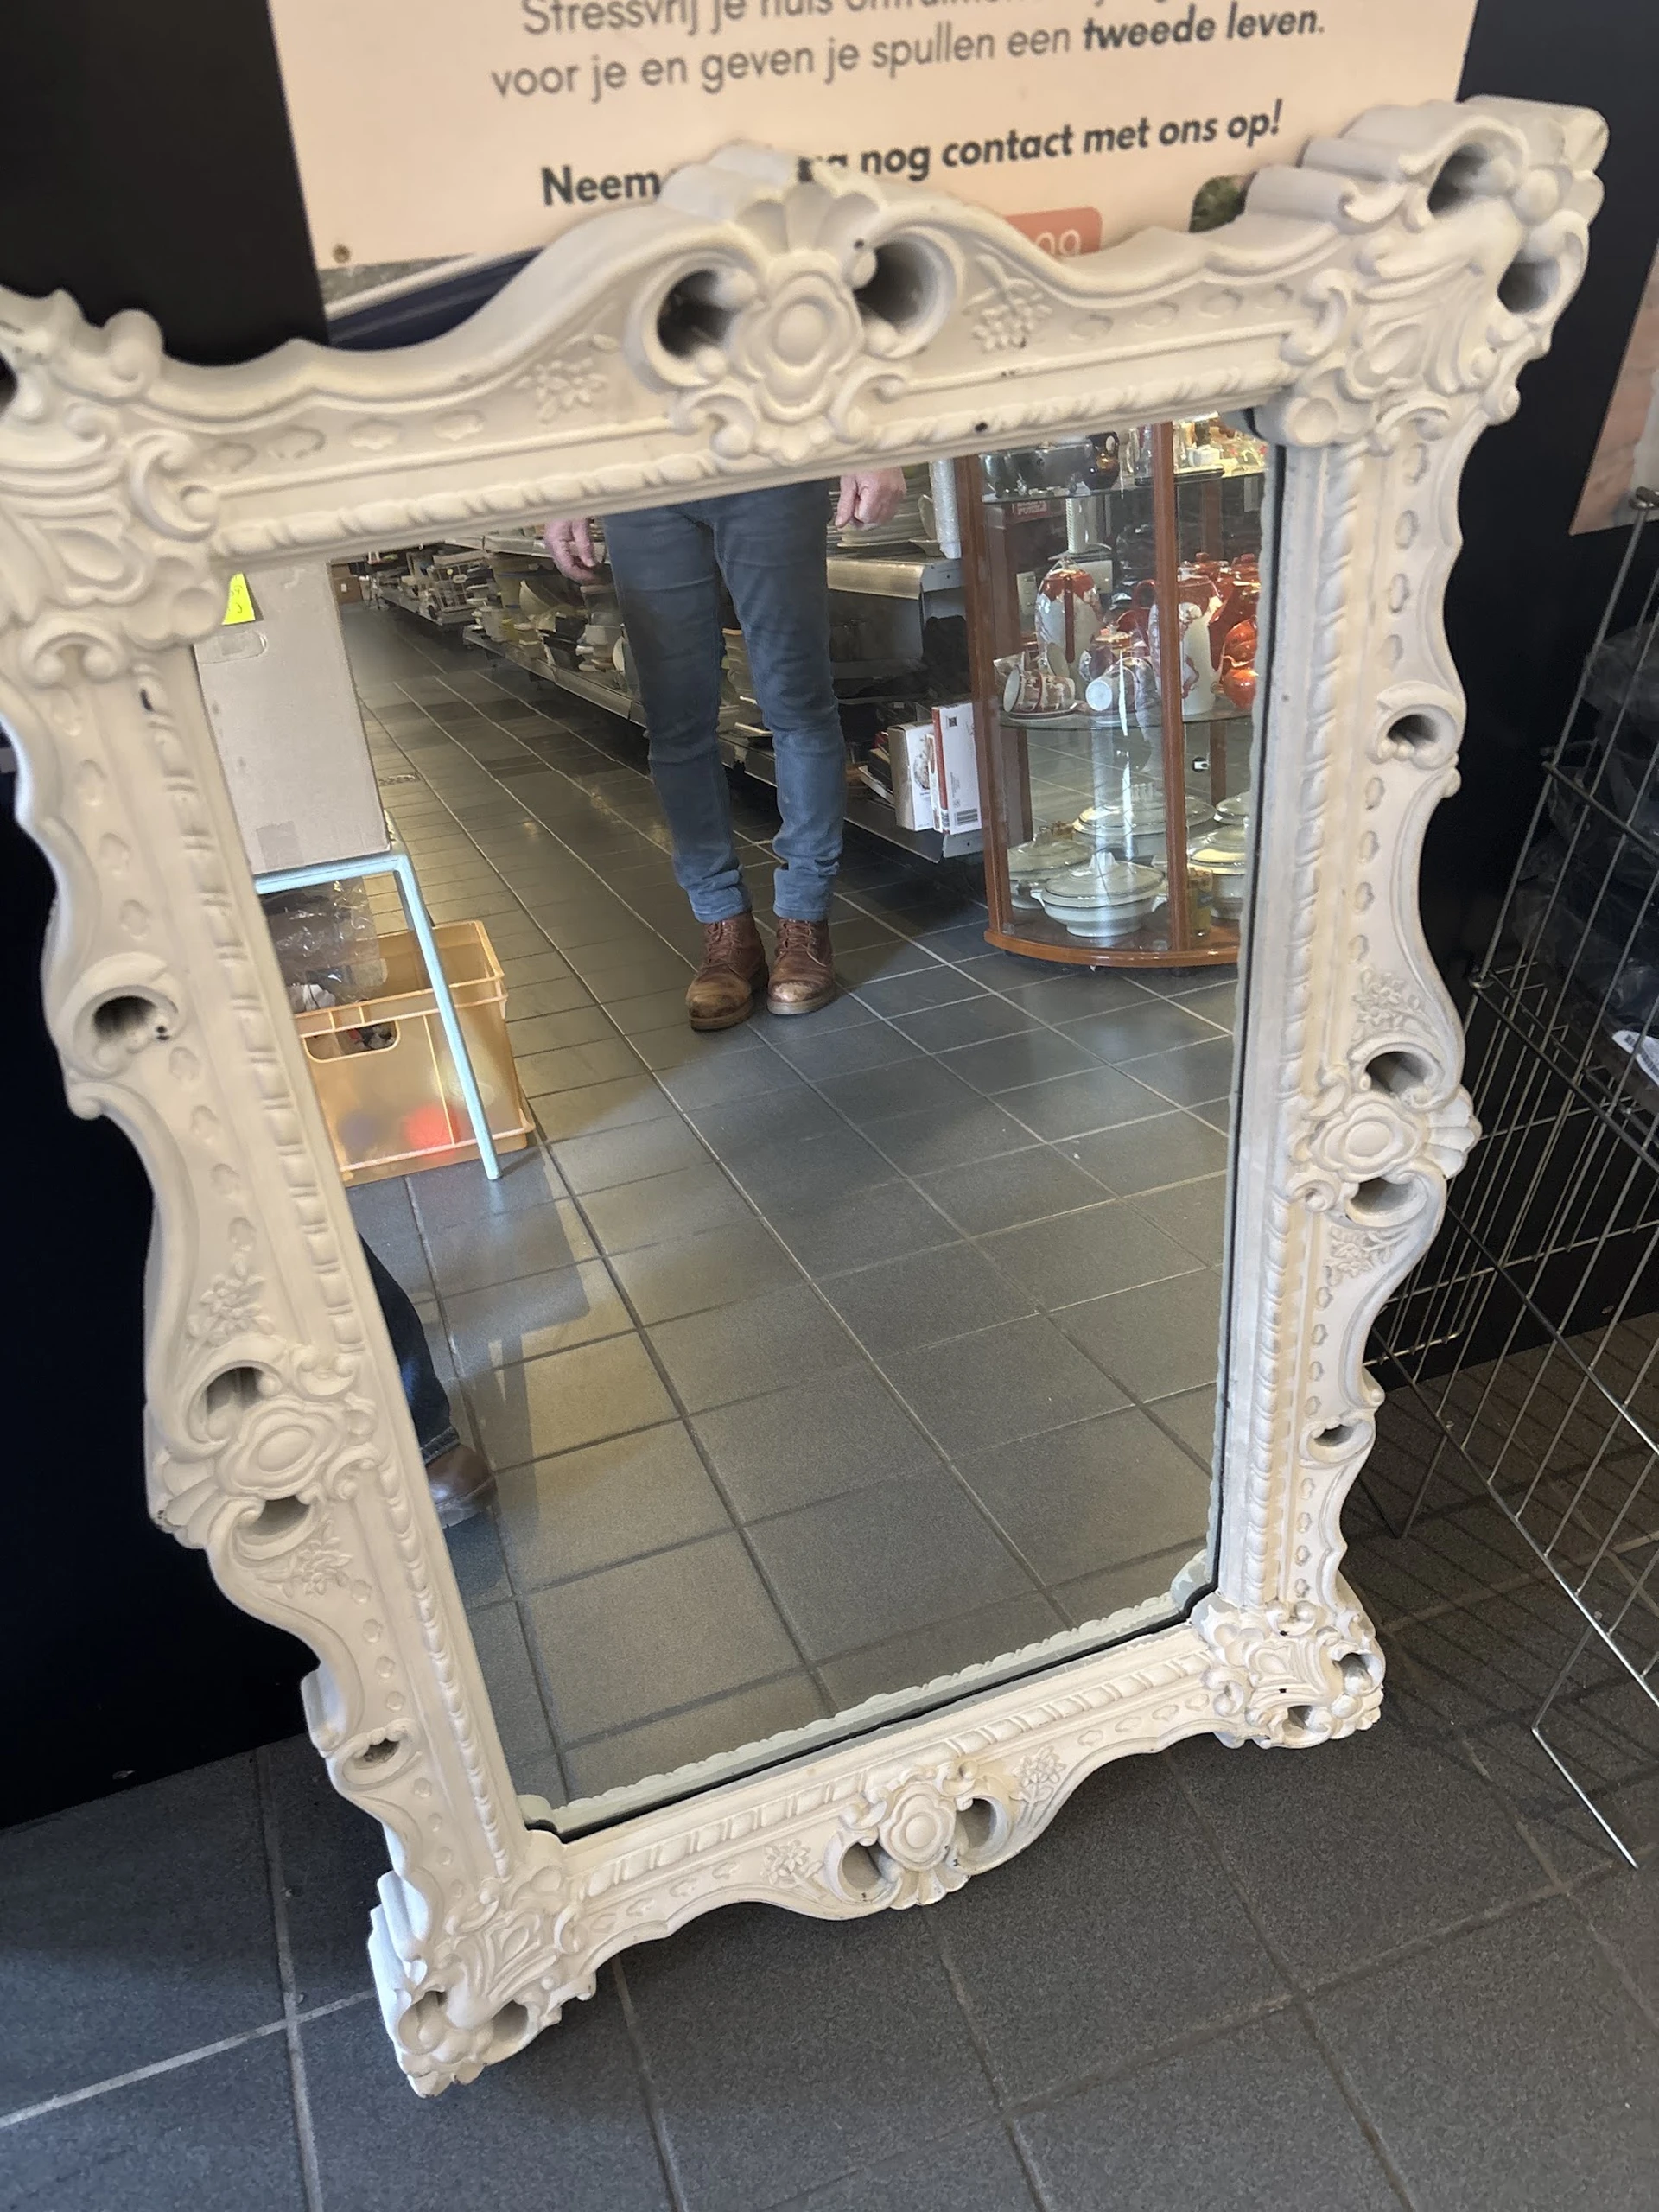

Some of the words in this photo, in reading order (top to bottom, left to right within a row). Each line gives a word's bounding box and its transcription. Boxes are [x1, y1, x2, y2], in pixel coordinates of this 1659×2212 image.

[491, 65, 580, 97] voor
[591, 54, 627, 104] je
[640, 56, 687, 86] en
[701, 47, 814, 94] geven
[824, 36, 860, 85] je
[871, 20, 995, 79] spullen
[1007, 27, 1071, 57] een
[1083, 3, 1216, 50] tweede
[1226, 0, 1325, 39] leven.
[710, 0, 746, 35] je
[541, 164, 661, 207] Neem
[861, 145, 931, 181] nog
[941, 124, 1074, 168] contact
[1082, 116, 1150, 154] met
[1158, 115, 1218, 147] ons
[1226, 97, 1284, 148] op!
